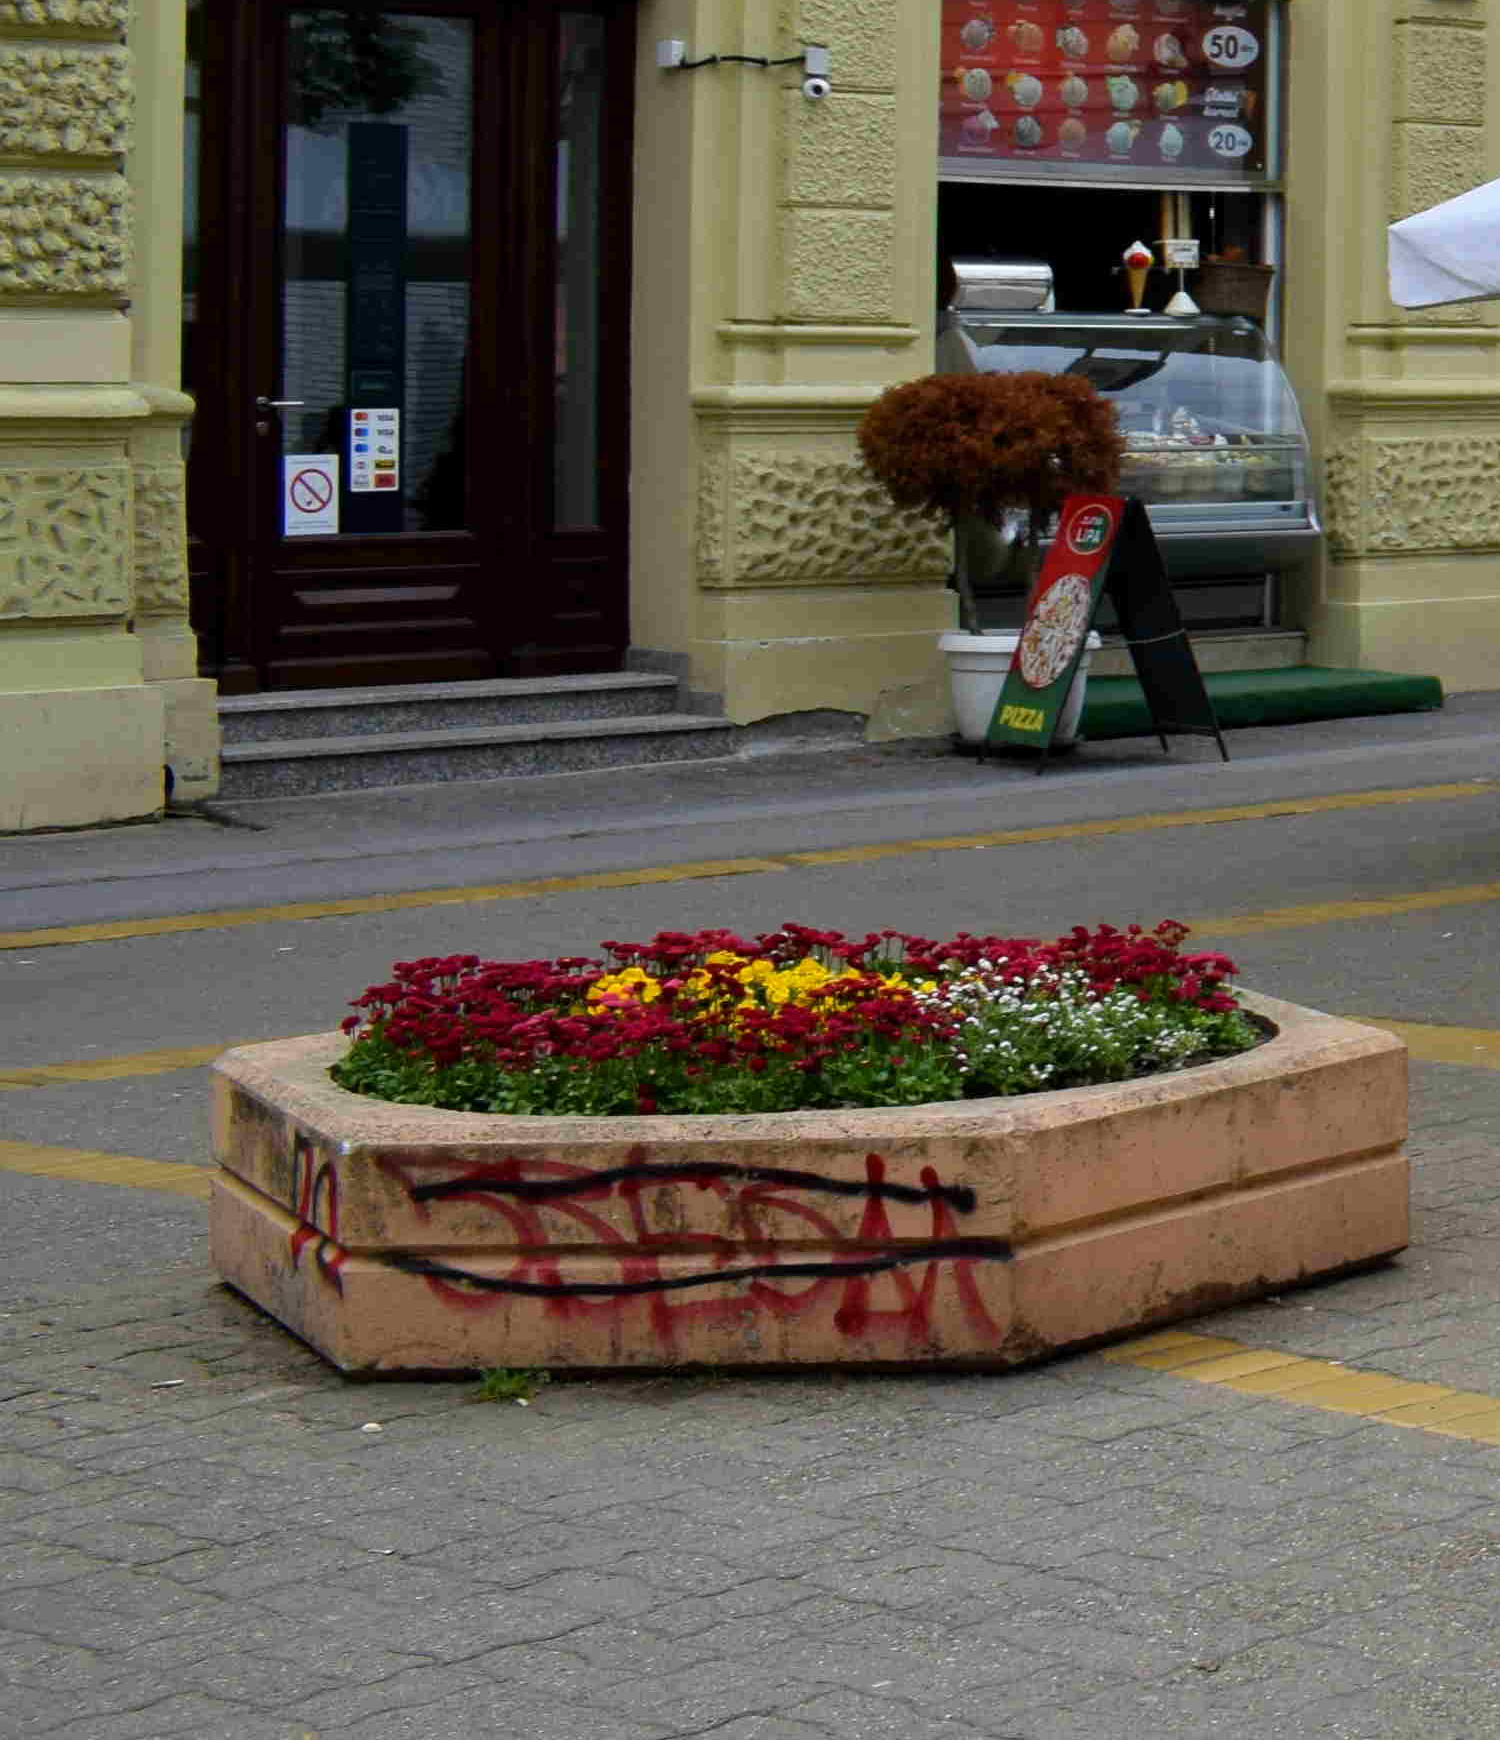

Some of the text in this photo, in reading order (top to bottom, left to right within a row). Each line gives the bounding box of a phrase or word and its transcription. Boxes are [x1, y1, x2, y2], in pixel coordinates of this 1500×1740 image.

[1209, 33, 1239, 59] 50
[1213, 131, 1237, 151] 20
[1000, 705, 1045, 731] PIZZA
